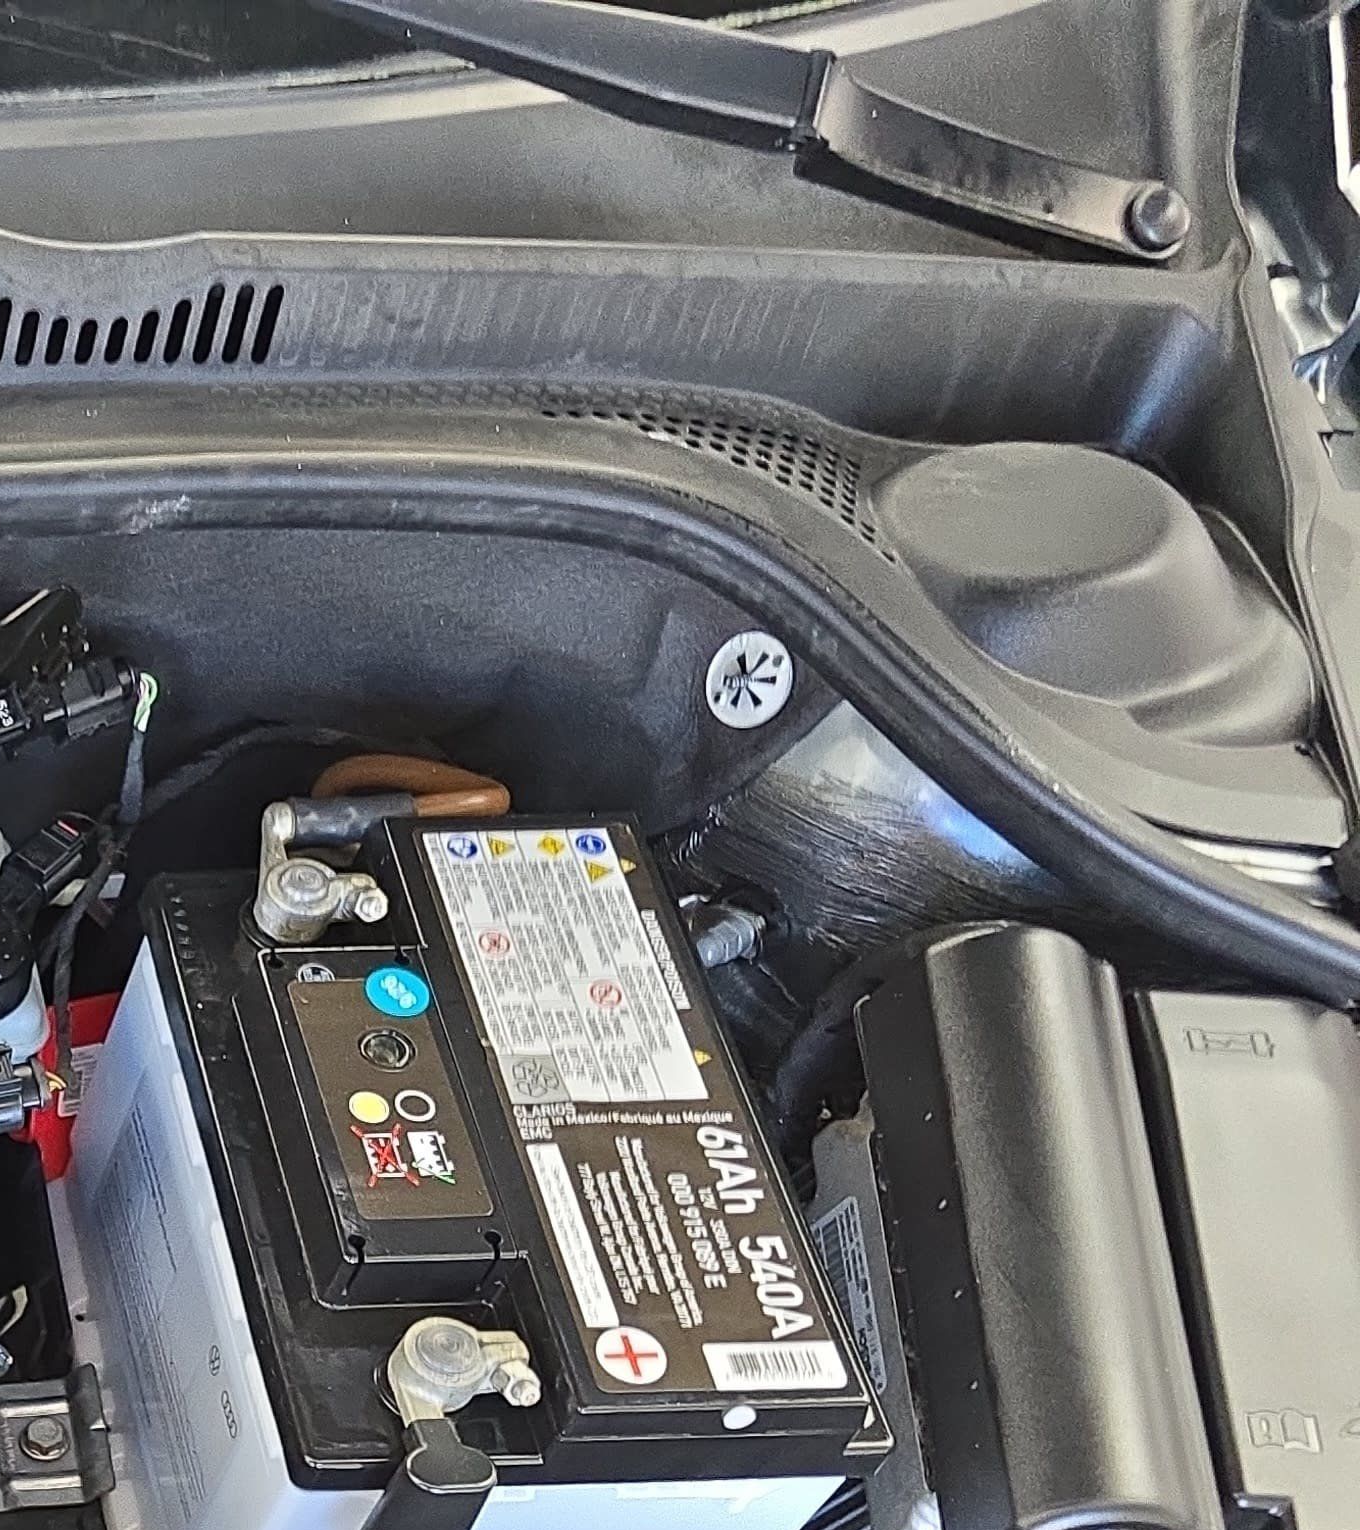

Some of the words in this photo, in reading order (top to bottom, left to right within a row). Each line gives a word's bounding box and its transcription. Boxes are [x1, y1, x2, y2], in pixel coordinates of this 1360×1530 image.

[513, 1101, 577, 1118] CLARIOS
[517, 1116, 550, 1127] Made
[520, 1126, 553, 1140] EMC
[693, 1125, 770, 1214] 61Ah
[735, 1235, 819, 1339] 540A
[701, 1273, 728, 1288] E
